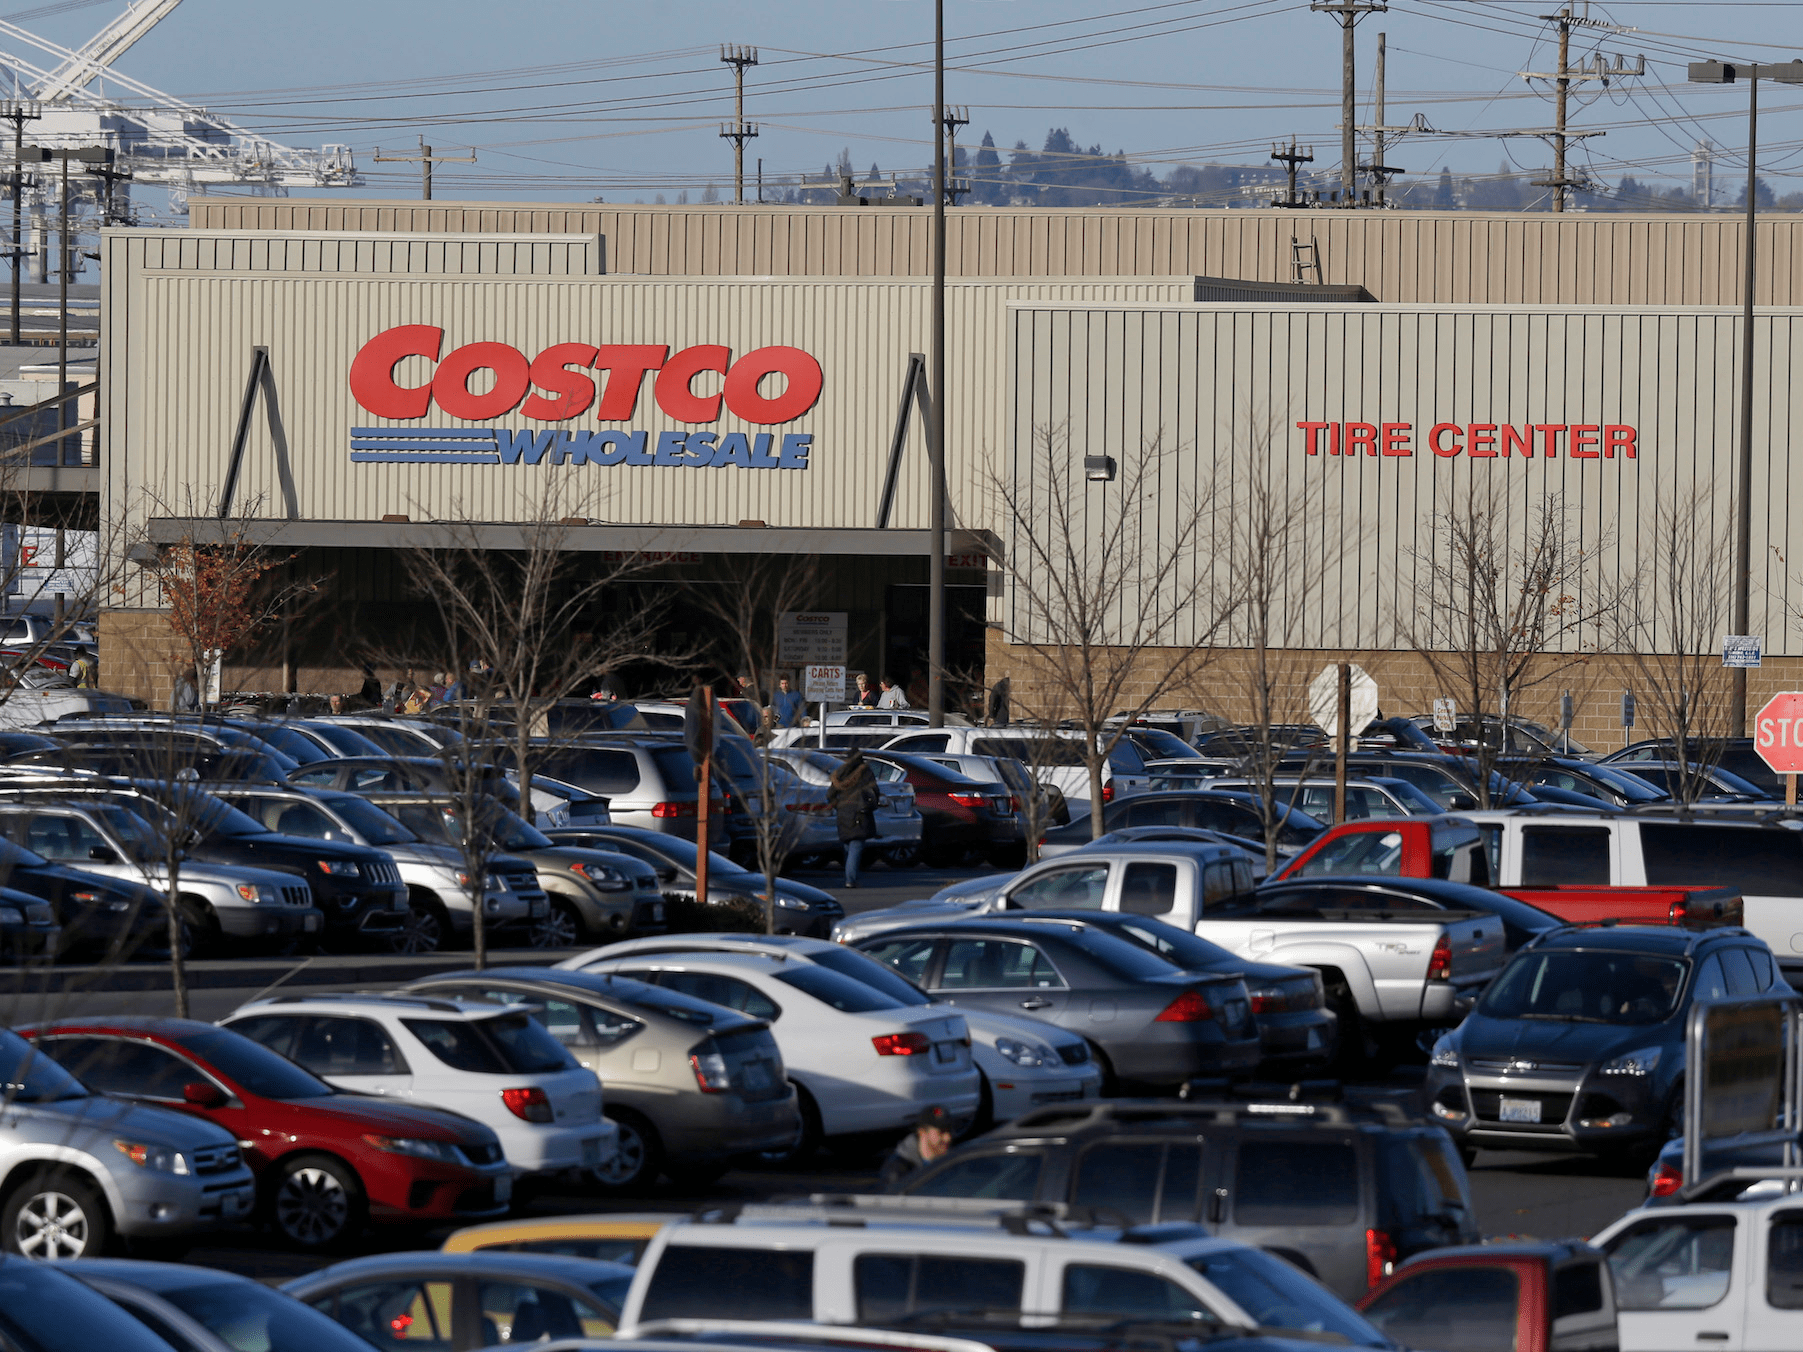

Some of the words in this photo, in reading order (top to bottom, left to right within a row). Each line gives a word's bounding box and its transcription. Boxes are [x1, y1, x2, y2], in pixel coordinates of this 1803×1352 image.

[350, 324, 823, 425] COSTCO
[495, 429, 814, 469] WHOLESALE
[1297, 421, 1412, 456] TIRE
[1428, 422, 1637, 458] CENTER
[948, 554, 986, 566] EXIT
[812, 667, 840, 679] CARTS
[1758, 718, 1803, 747] STO
